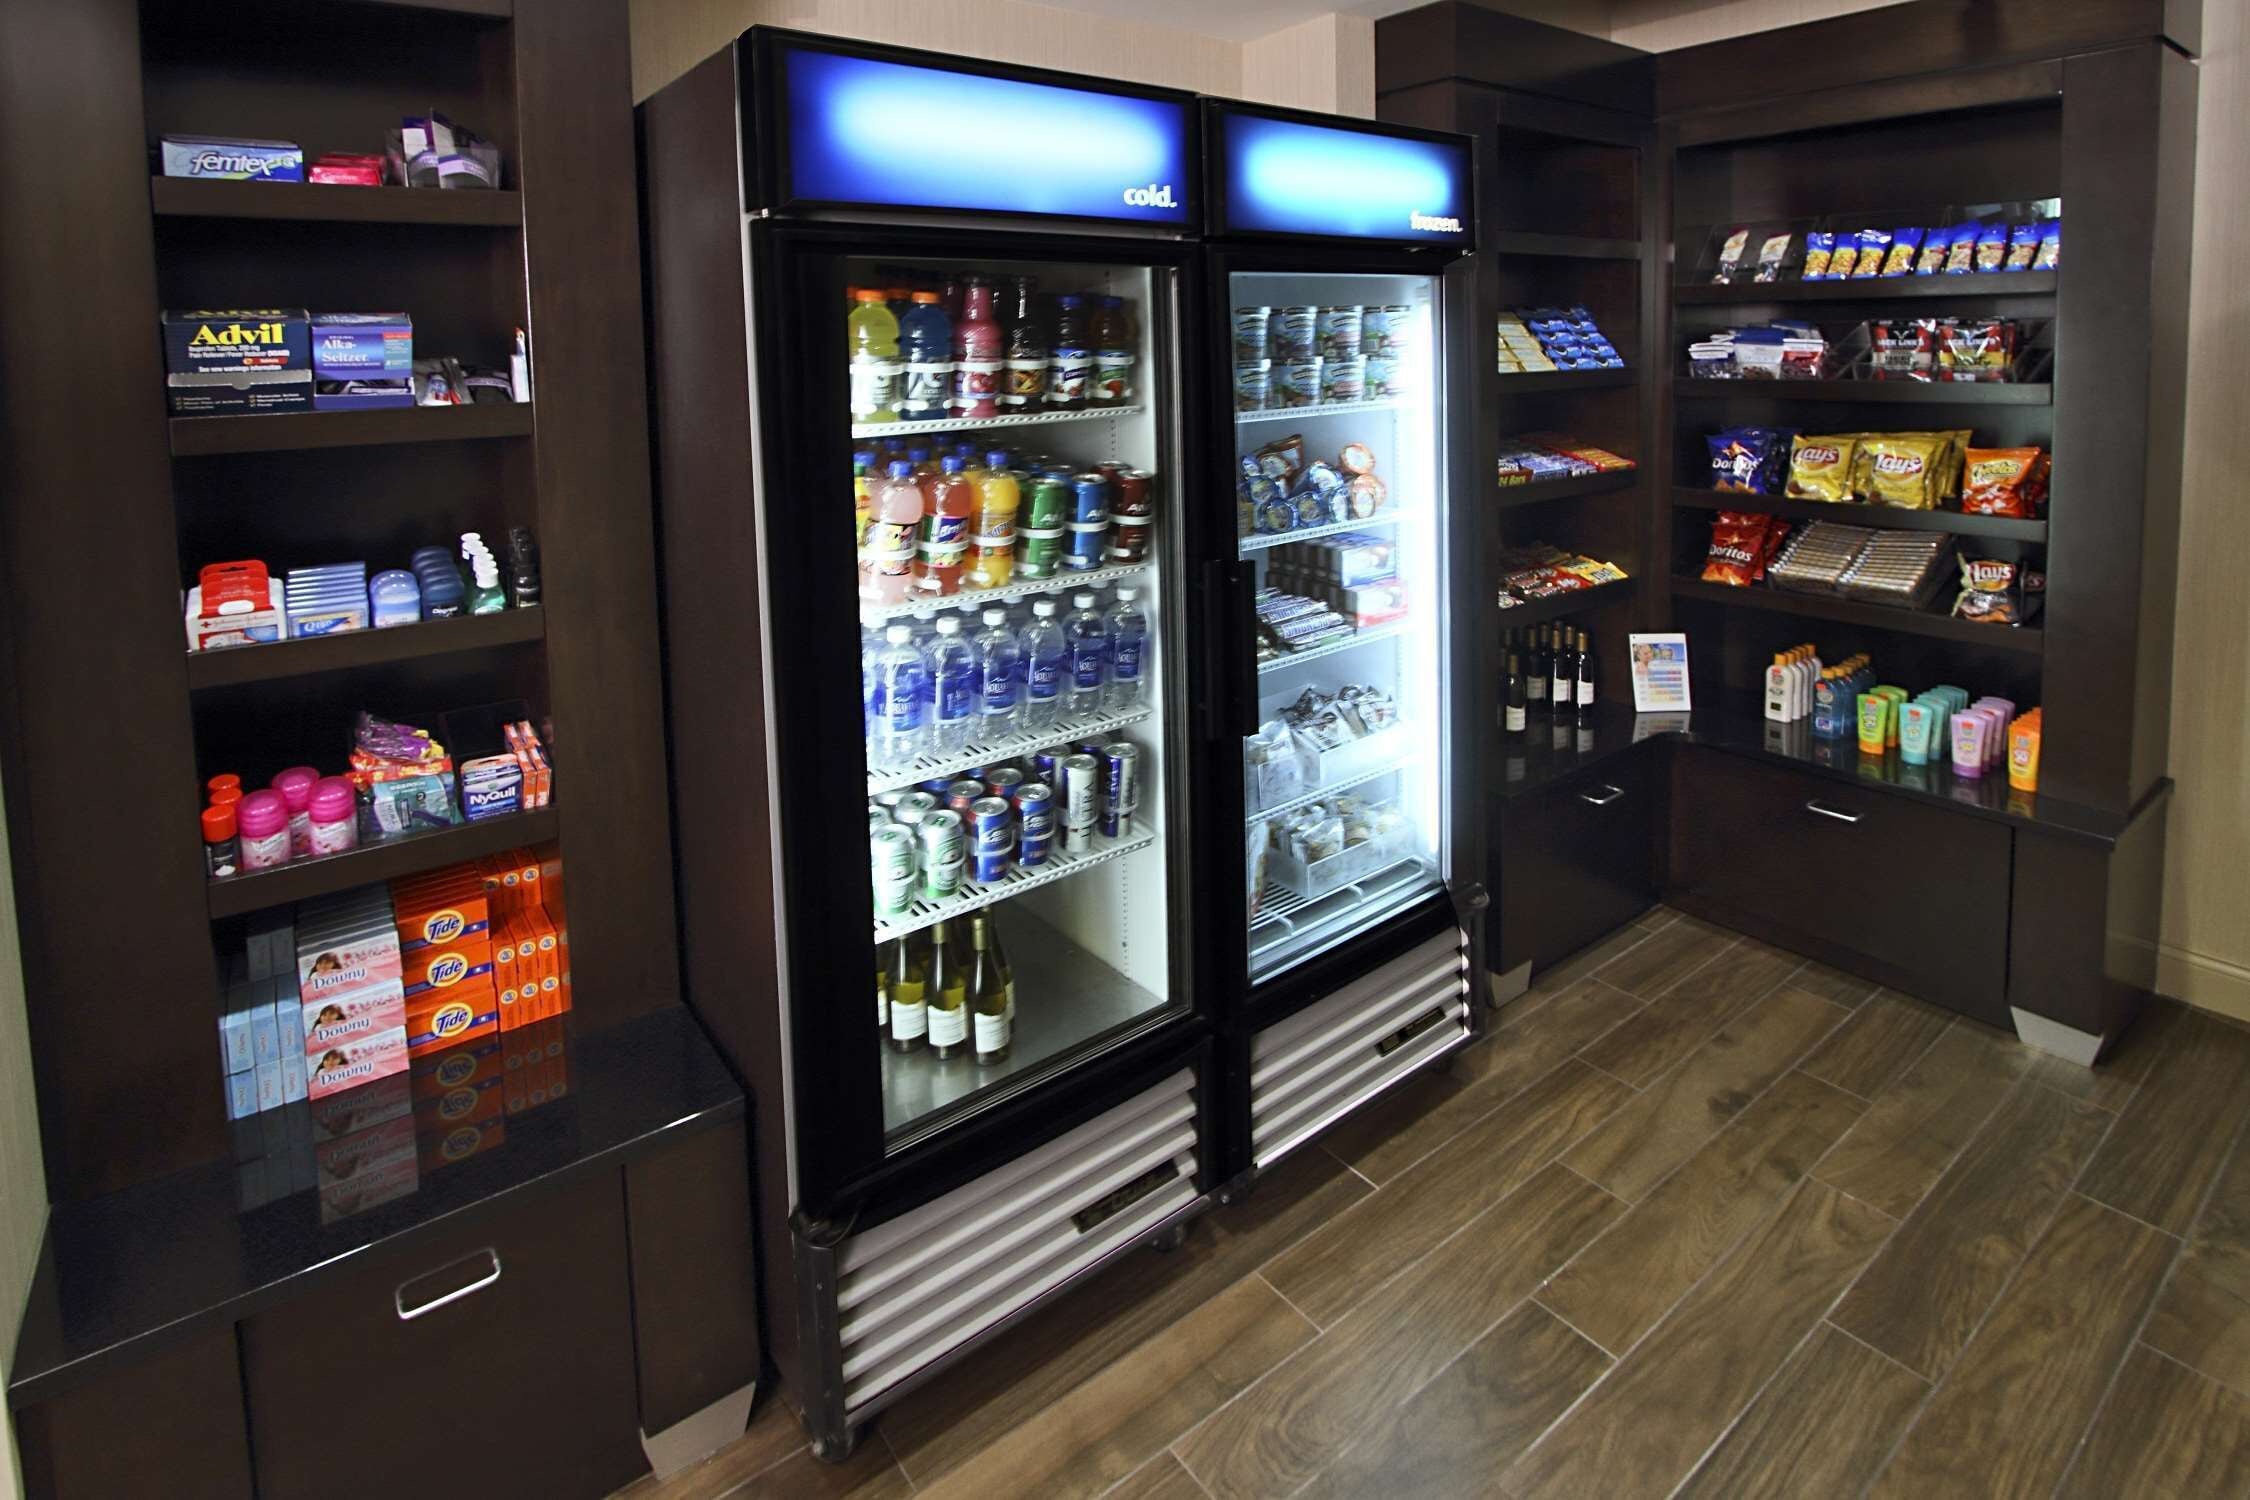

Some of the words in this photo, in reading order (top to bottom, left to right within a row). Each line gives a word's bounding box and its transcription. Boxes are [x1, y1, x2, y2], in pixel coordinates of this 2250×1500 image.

[1123, 184, 1178, 208] cold.
[189, 323, 284, 345] Advil
[427, 917, 460, 940] Tide
[314, 967, 366, 990] Downy
[431, 960, 463, 984] Tide
[318, 1018, 370, 1041] Downy
[436, 1009, 468, 1033] Tide
[320, 1062, 373, 1086] Downy
